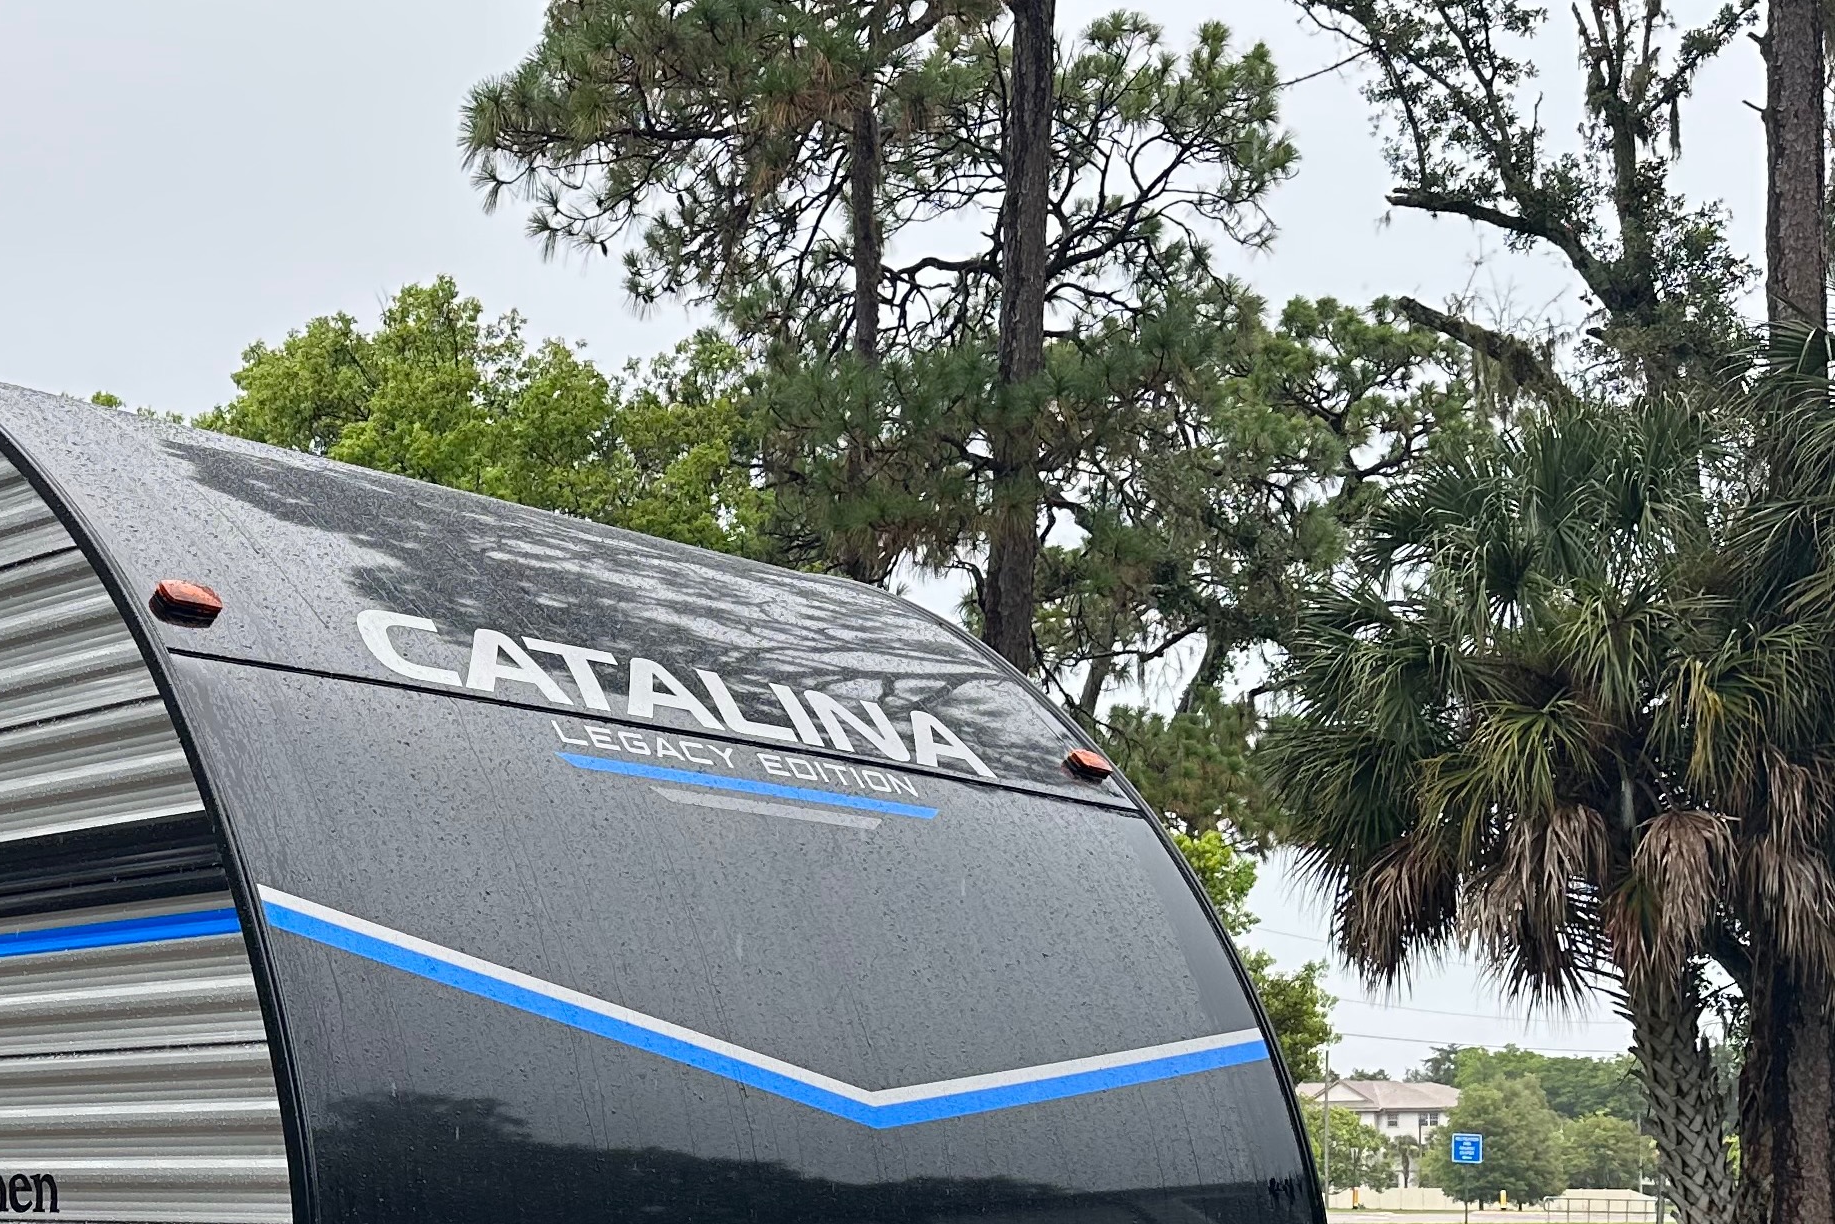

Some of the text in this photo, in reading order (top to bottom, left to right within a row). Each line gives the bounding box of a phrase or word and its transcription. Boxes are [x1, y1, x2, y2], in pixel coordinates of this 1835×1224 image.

[356, 608, 997, 778] CATALINA
[550, 719, 919, 798] LEGACY EDITION
